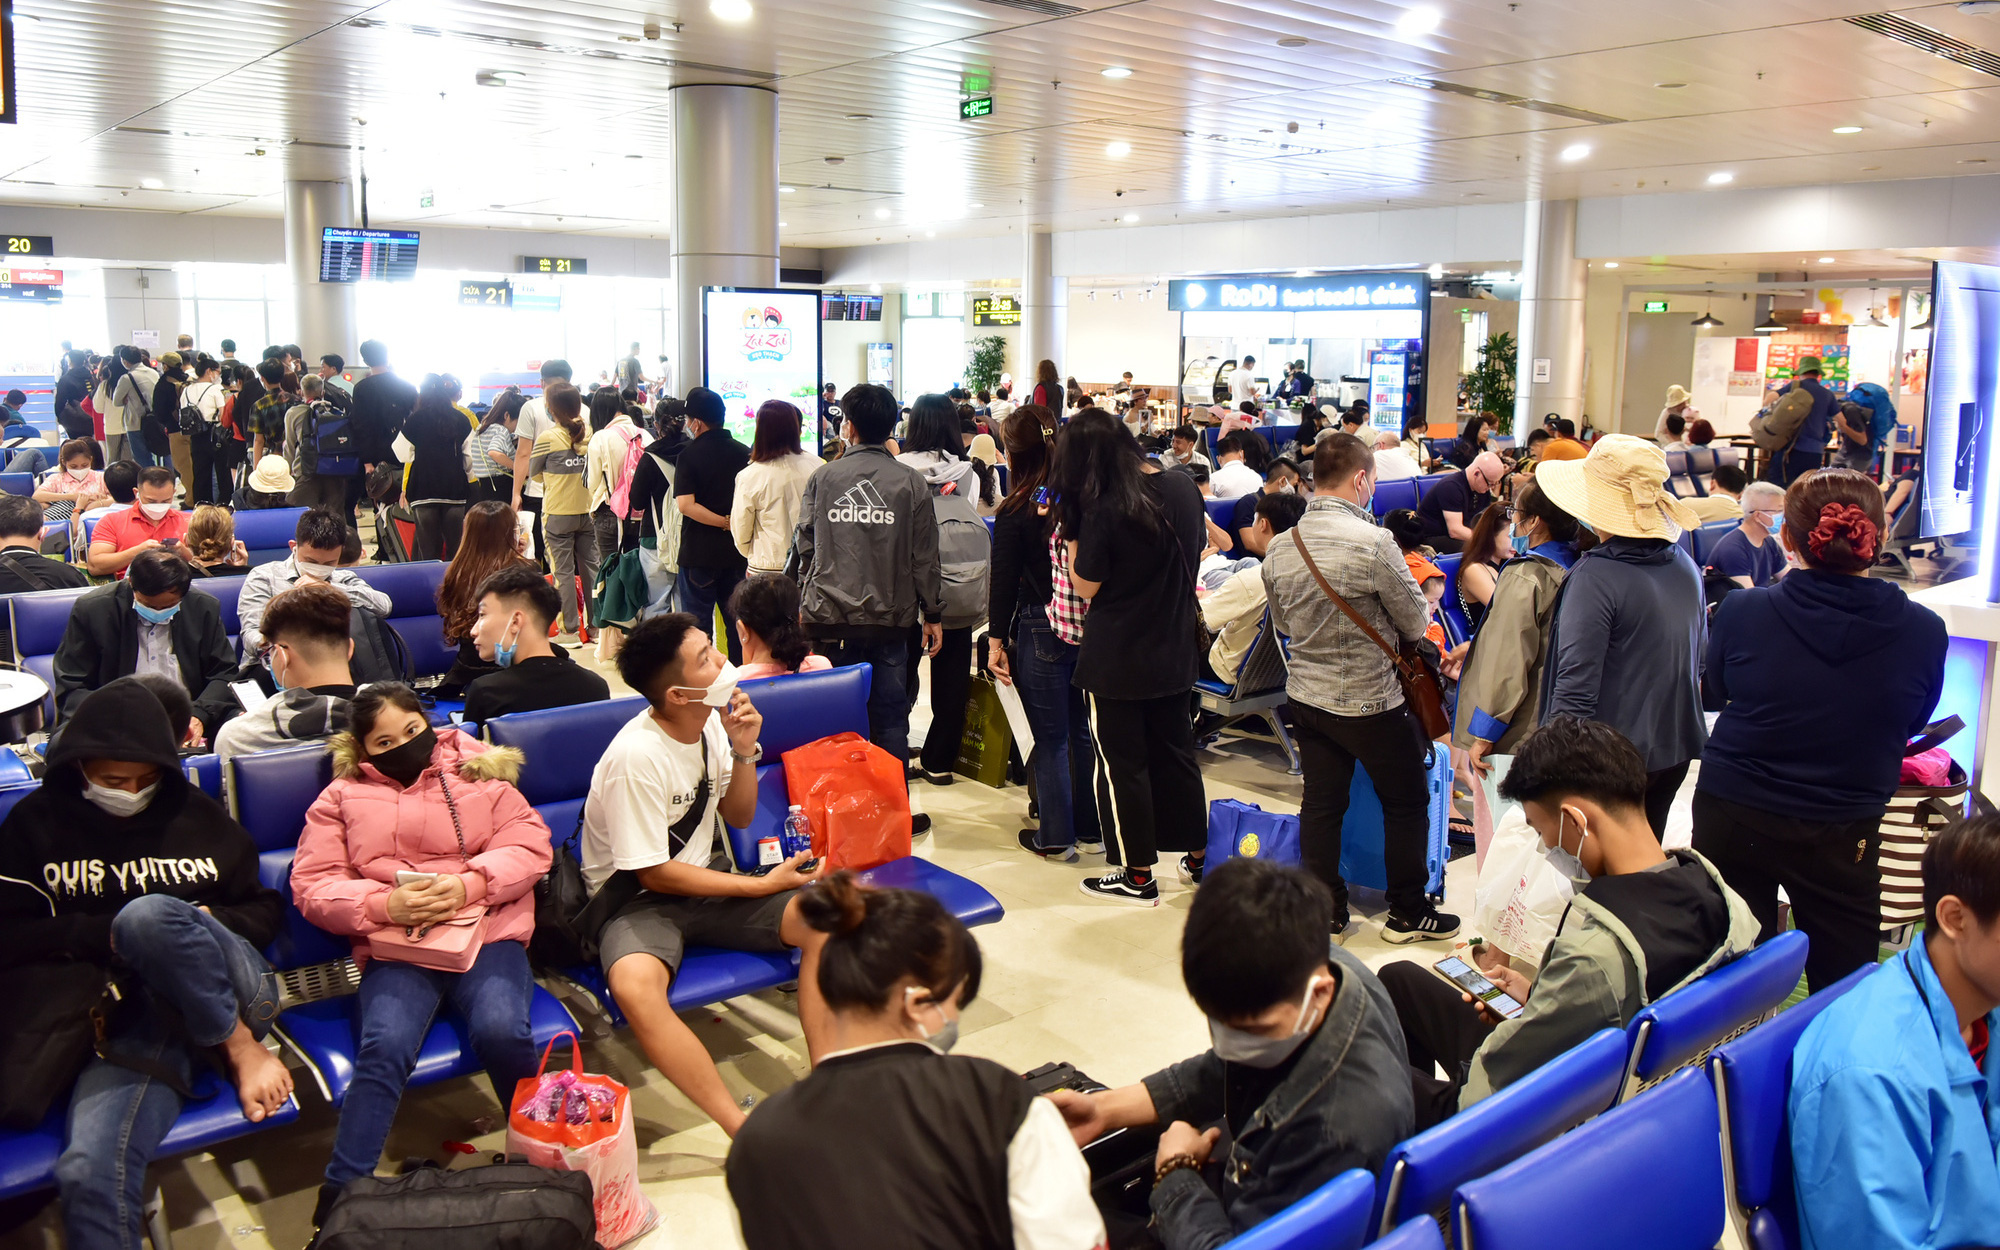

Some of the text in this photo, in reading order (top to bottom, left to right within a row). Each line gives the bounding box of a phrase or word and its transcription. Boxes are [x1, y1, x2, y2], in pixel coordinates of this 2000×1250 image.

[362, 230, 390, 238] Departures
[8, 237, 32, 253] 20
[556, 259, 571, 272] 21
[462, 285, 480, 296] CỬA
[485, 287, 507, 305] 21
[1316, 287, 1355, 306] food
[1355, 285, 1370, 305] &
[1371, 282, 1417, 305] drink
[827, 504, 895, 525] adidas
[110, 857, 218, 894] VUITTON
